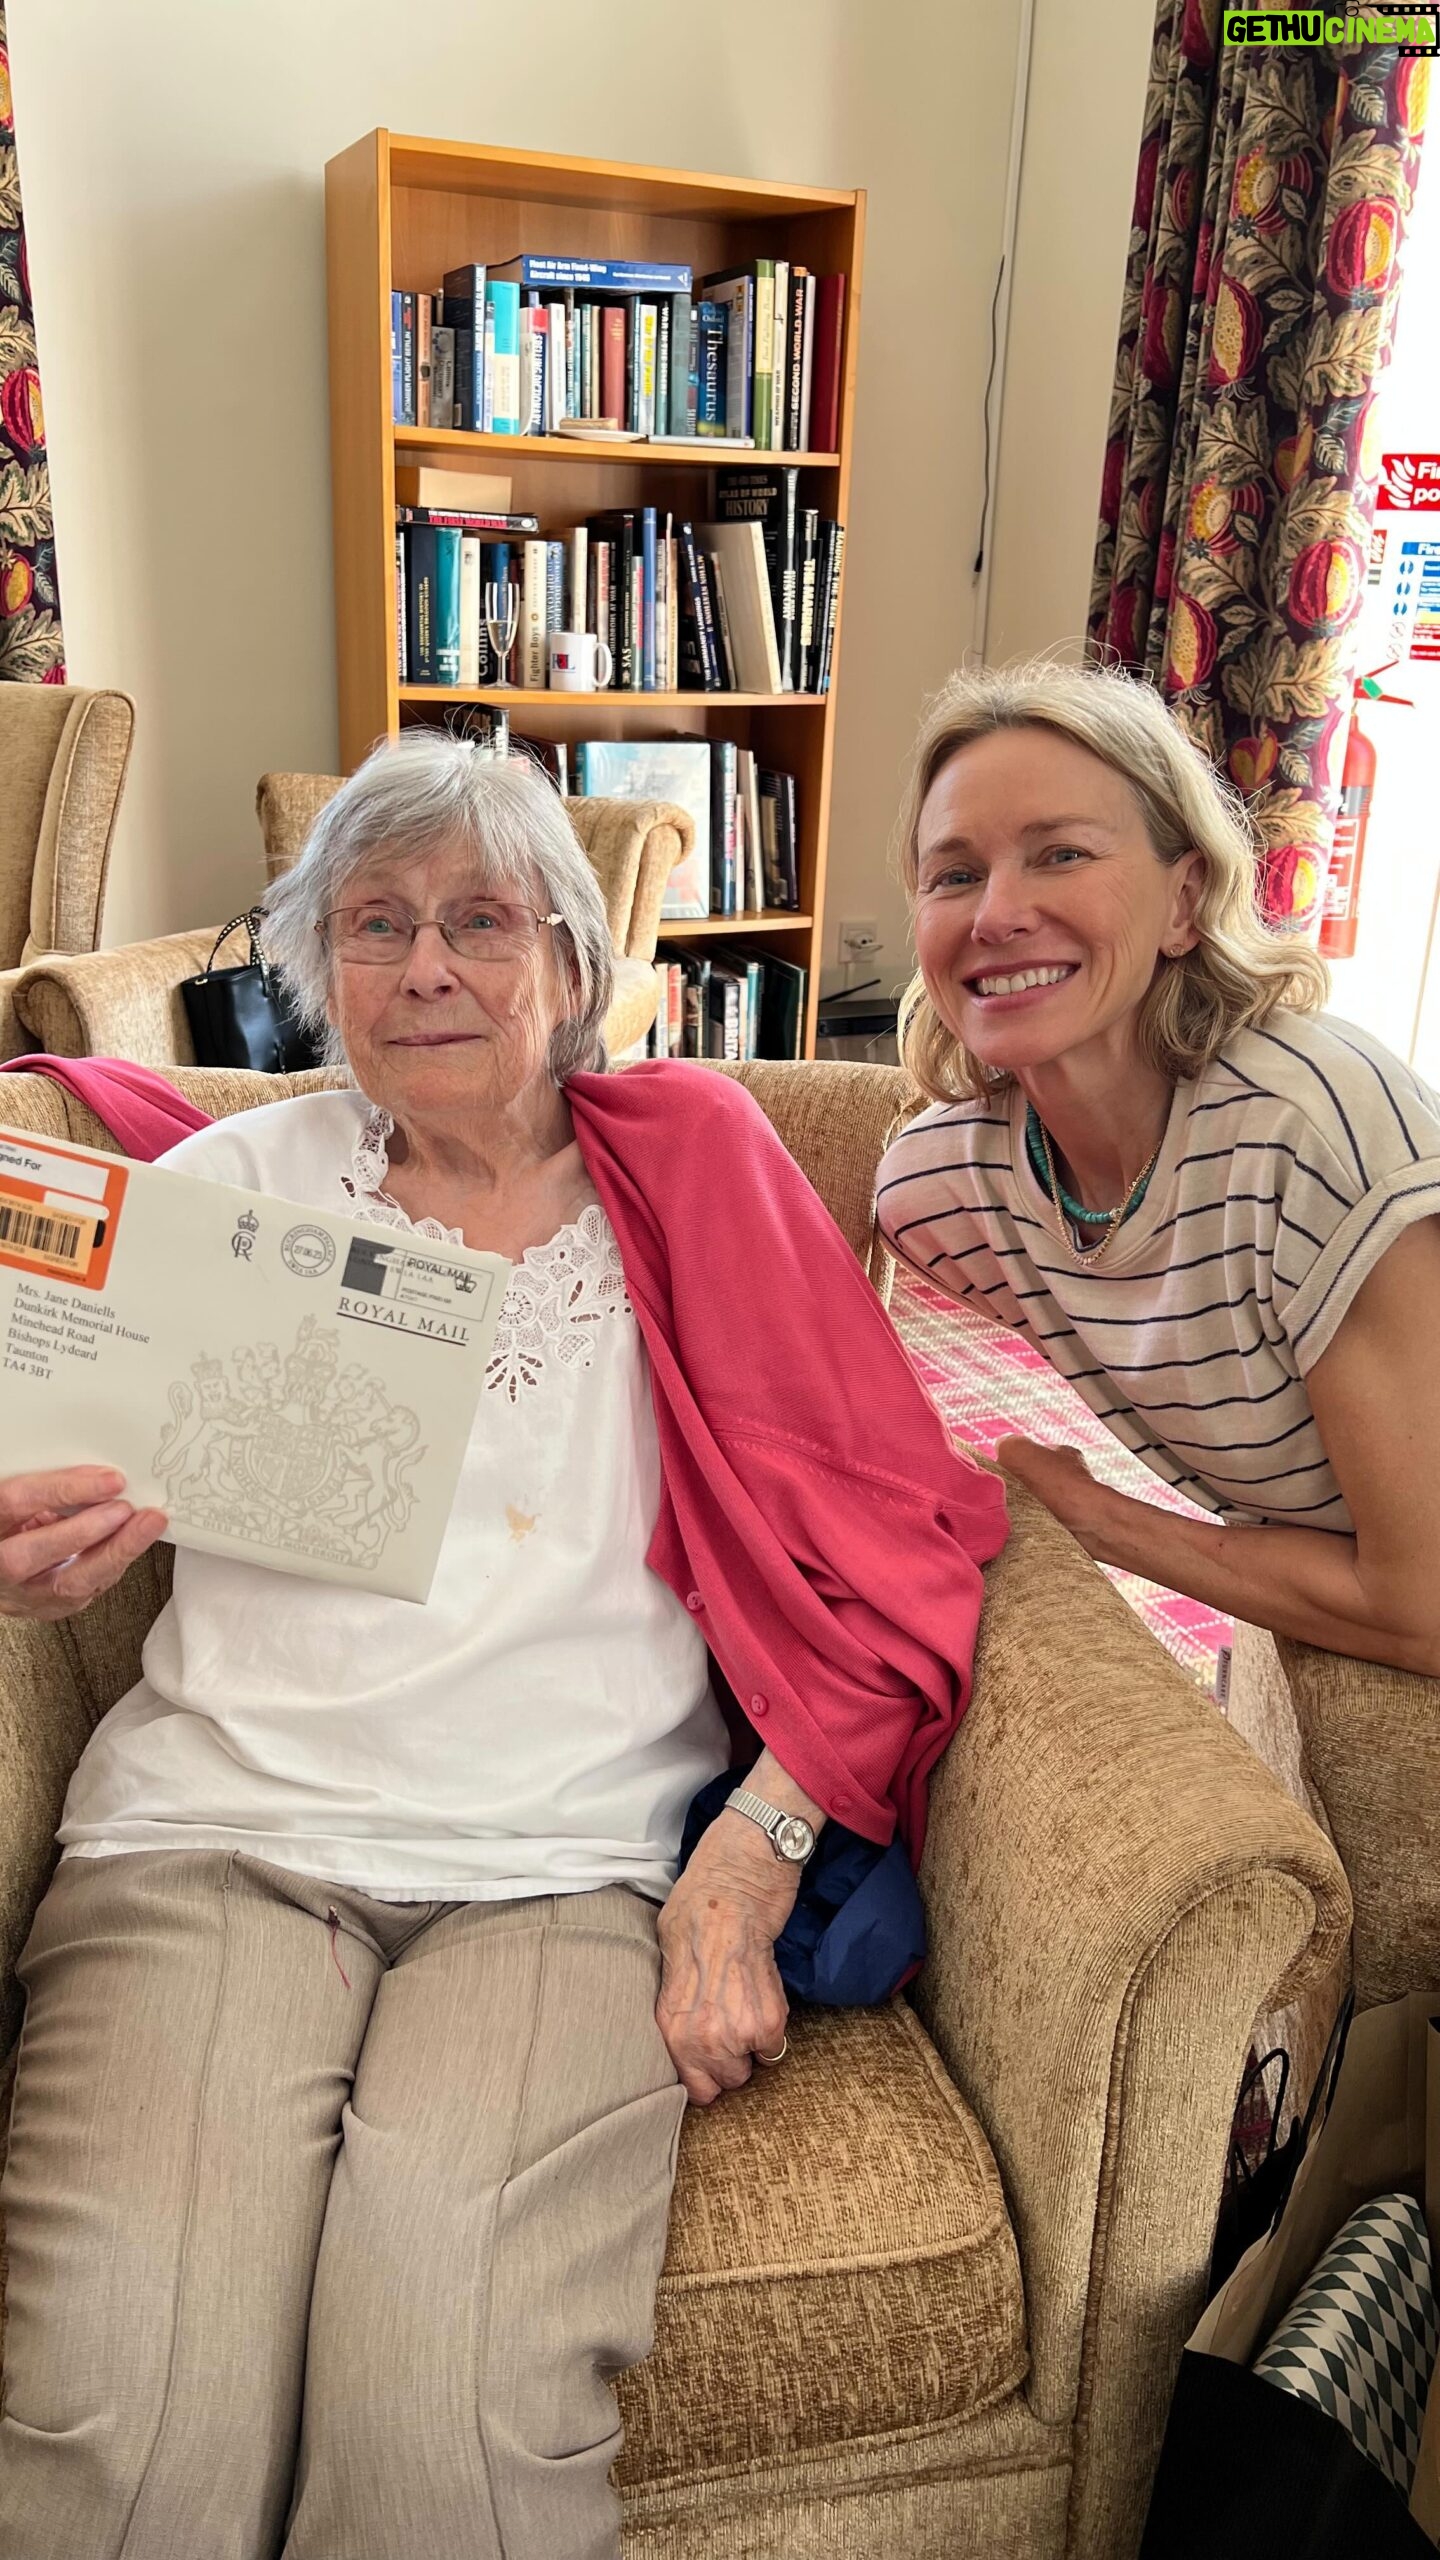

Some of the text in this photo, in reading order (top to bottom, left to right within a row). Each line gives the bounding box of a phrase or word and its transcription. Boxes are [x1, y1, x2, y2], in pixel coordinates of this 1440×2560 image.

[794, 289, 803, 316] WAR
[404, 331, 412, 356] BERLIN
[793, 319, 802, 360] WORLD
[404, 358, 412, 381] FLIGHT
[706, 325, 724, 421] Thesaurus
[532, 374, 542, 425] DICTIONARY
[791, 364, 800, 410] SECOND
[726, 498, 769, 516] HISTORY
[833, 530, 843, 573] RAIDING
[697, 554, 706, 585] ACTION
[831, 576, 839, 595] THE
[694, 597, 704, 630] LANDINGS
[701, 586, 712, 624] STATIONS
[801, 558, 815, 646] THE MARINES
[828, 599, 838, 628] REICH
[530, 626, 540, 682] Fighter Boys
[622, 648, 631, 668] SAS
[698, 631, 709, 668] NORMANDY
[24, 1159, 42, 1171] For
[408, 1258, 445, 1275] ROYAL
[17, 1283, 116, 1319] Mrs. Jane Daniells
[10, 1312, 96, 1345] Minehead Road
[13, 1297, 151, 1344] Dunkirk Memorial House
[338, 1297, 471, 1342] ROYAL MAIL
[5, 1342, 49, 1364] Taunton
[8, 1327, 98, 1362] Bishops Lydeard
[2, 1356, 54, 1381] TA4 3BT
